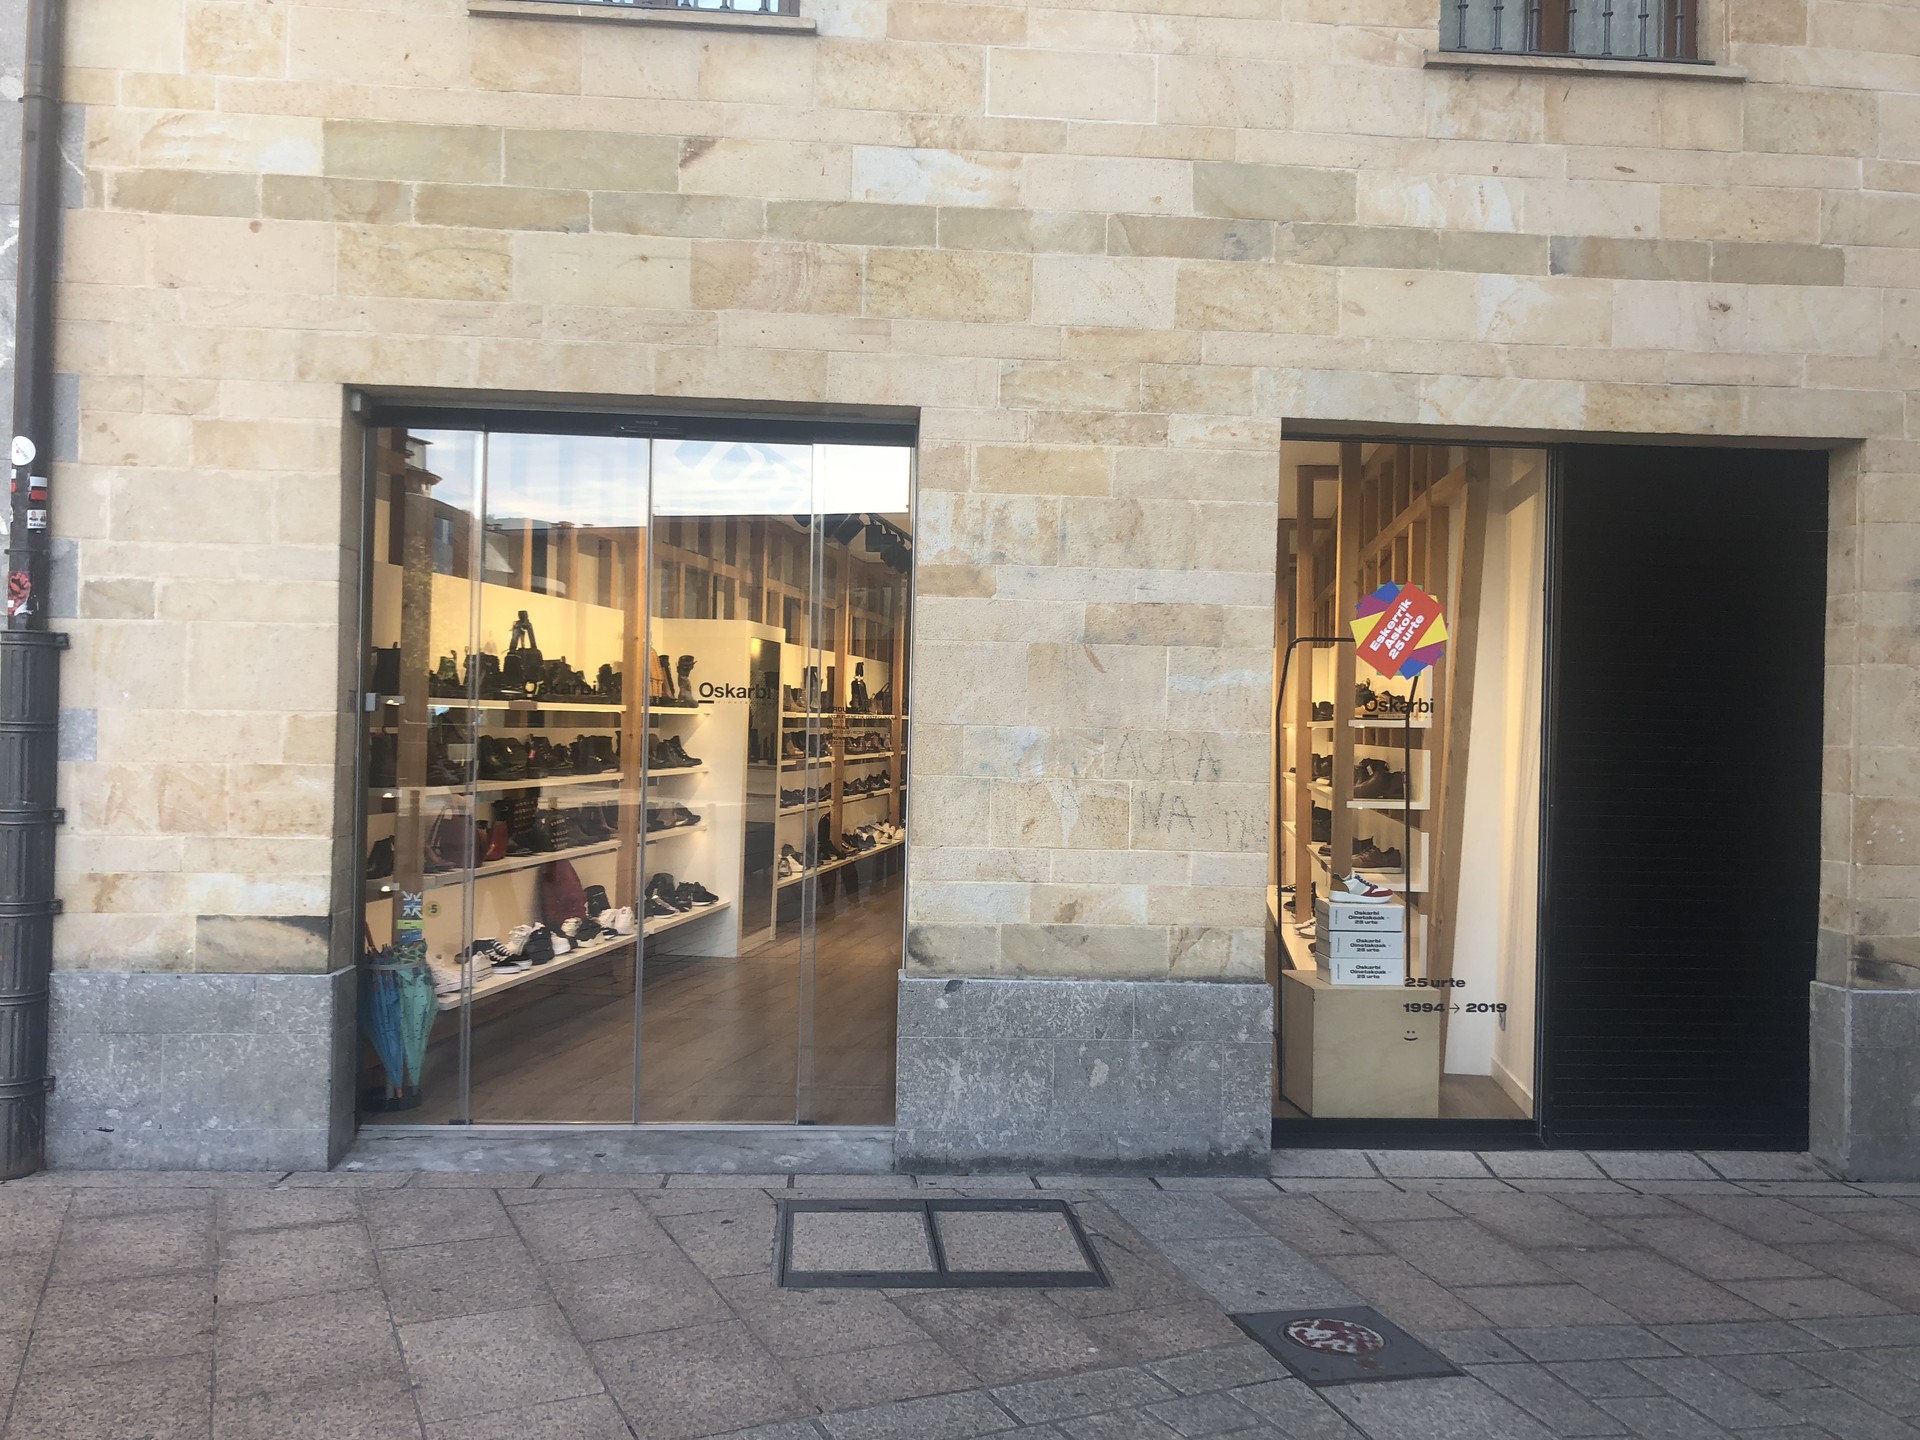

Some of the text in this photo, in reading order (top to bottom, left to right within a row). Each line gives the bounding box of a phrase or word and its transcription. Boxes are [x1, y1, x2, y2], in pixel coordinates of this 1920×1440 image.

[1369, 599, 1413, 652] Eskerrik
[1384, 612, 1413, 649] Asko!
[1388, 615, 1425, 660] 25 urte
[699, 682, 771, 698] Oskarbi
[1365, 698, 1434, 713] Oskarbi
[1404, 978, 1466, 988] 25 urte
[1403, 1003, 1507, 1013] 1994 2019
